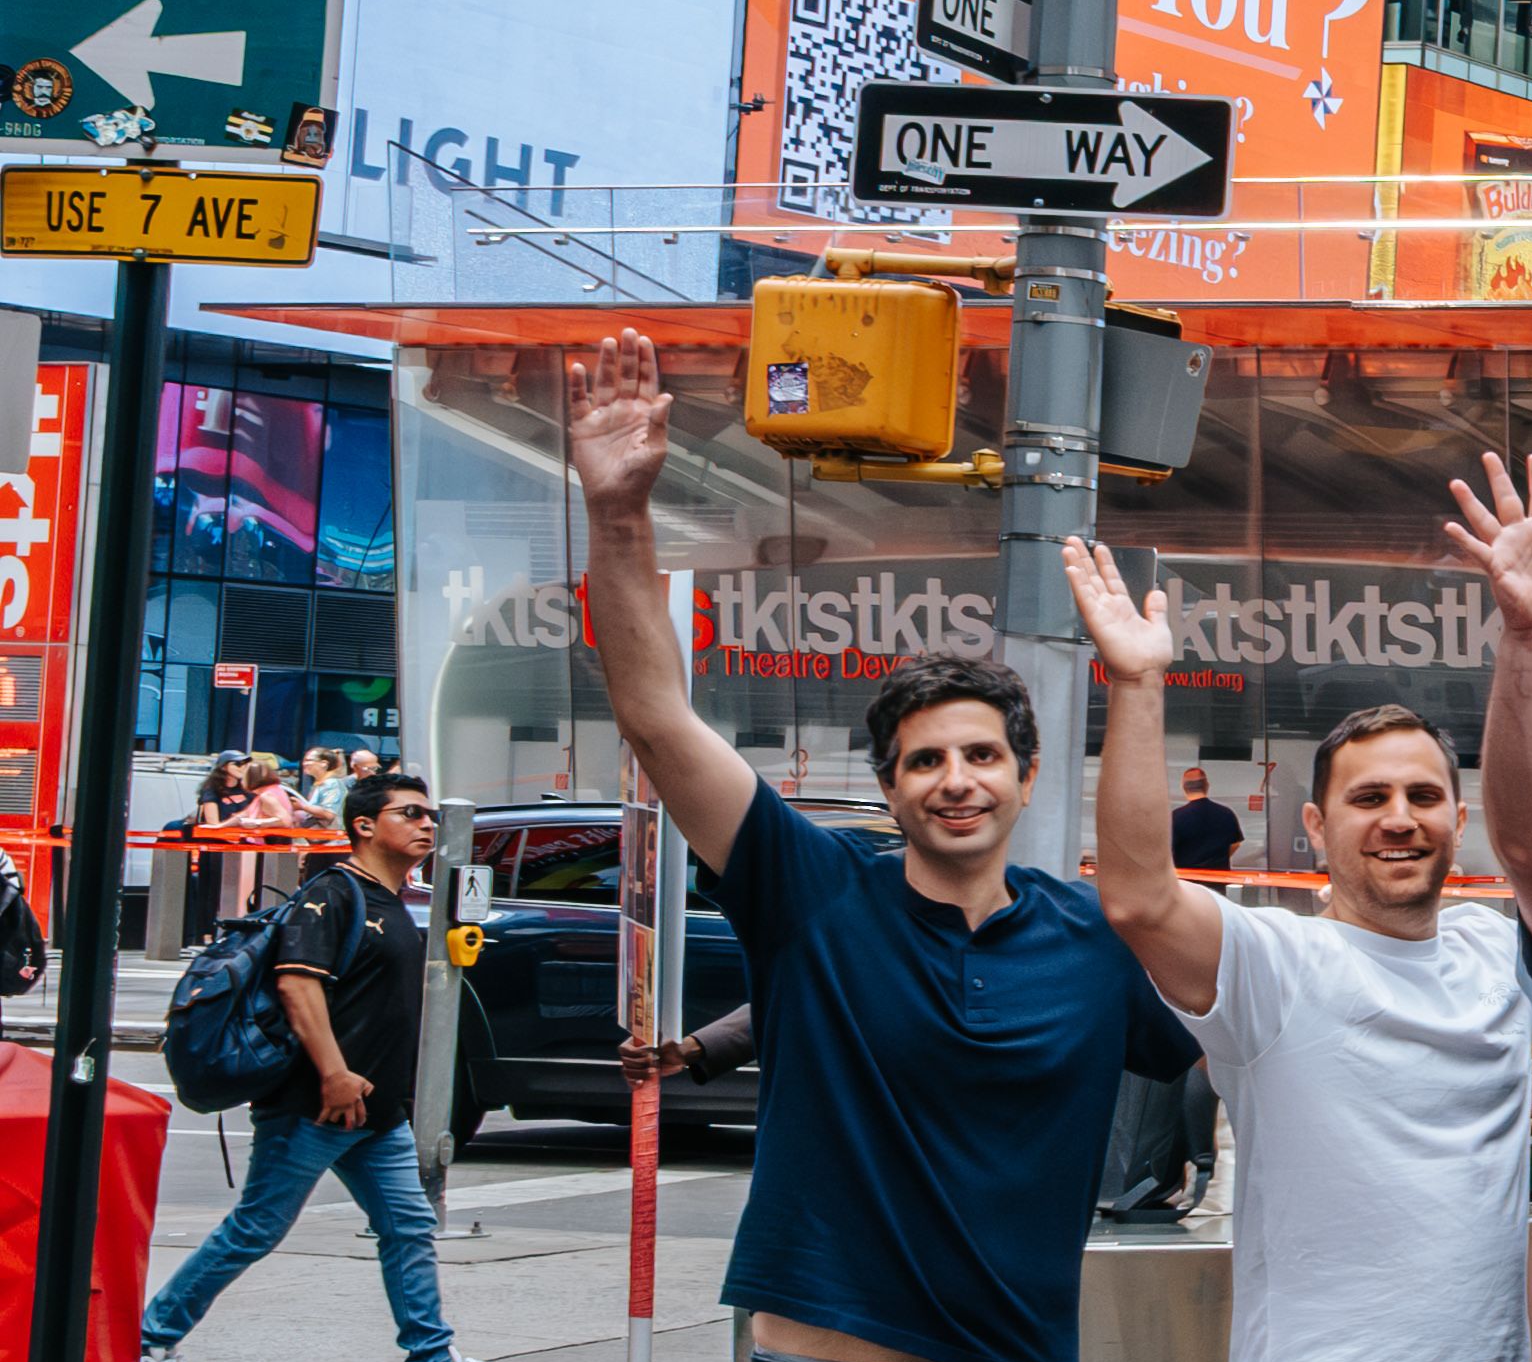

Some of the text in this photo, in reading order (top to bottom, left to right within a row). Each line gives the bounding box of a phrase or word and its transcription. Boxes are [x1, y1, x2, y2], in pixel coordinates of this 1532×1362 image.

[350, 106, 580, 218] LIGHT
[896, 121, 1169, 178] ONE WAY
[46, 190, 260, 240] USE 7 AVE
[720, 644, 832, 680] Theatre
